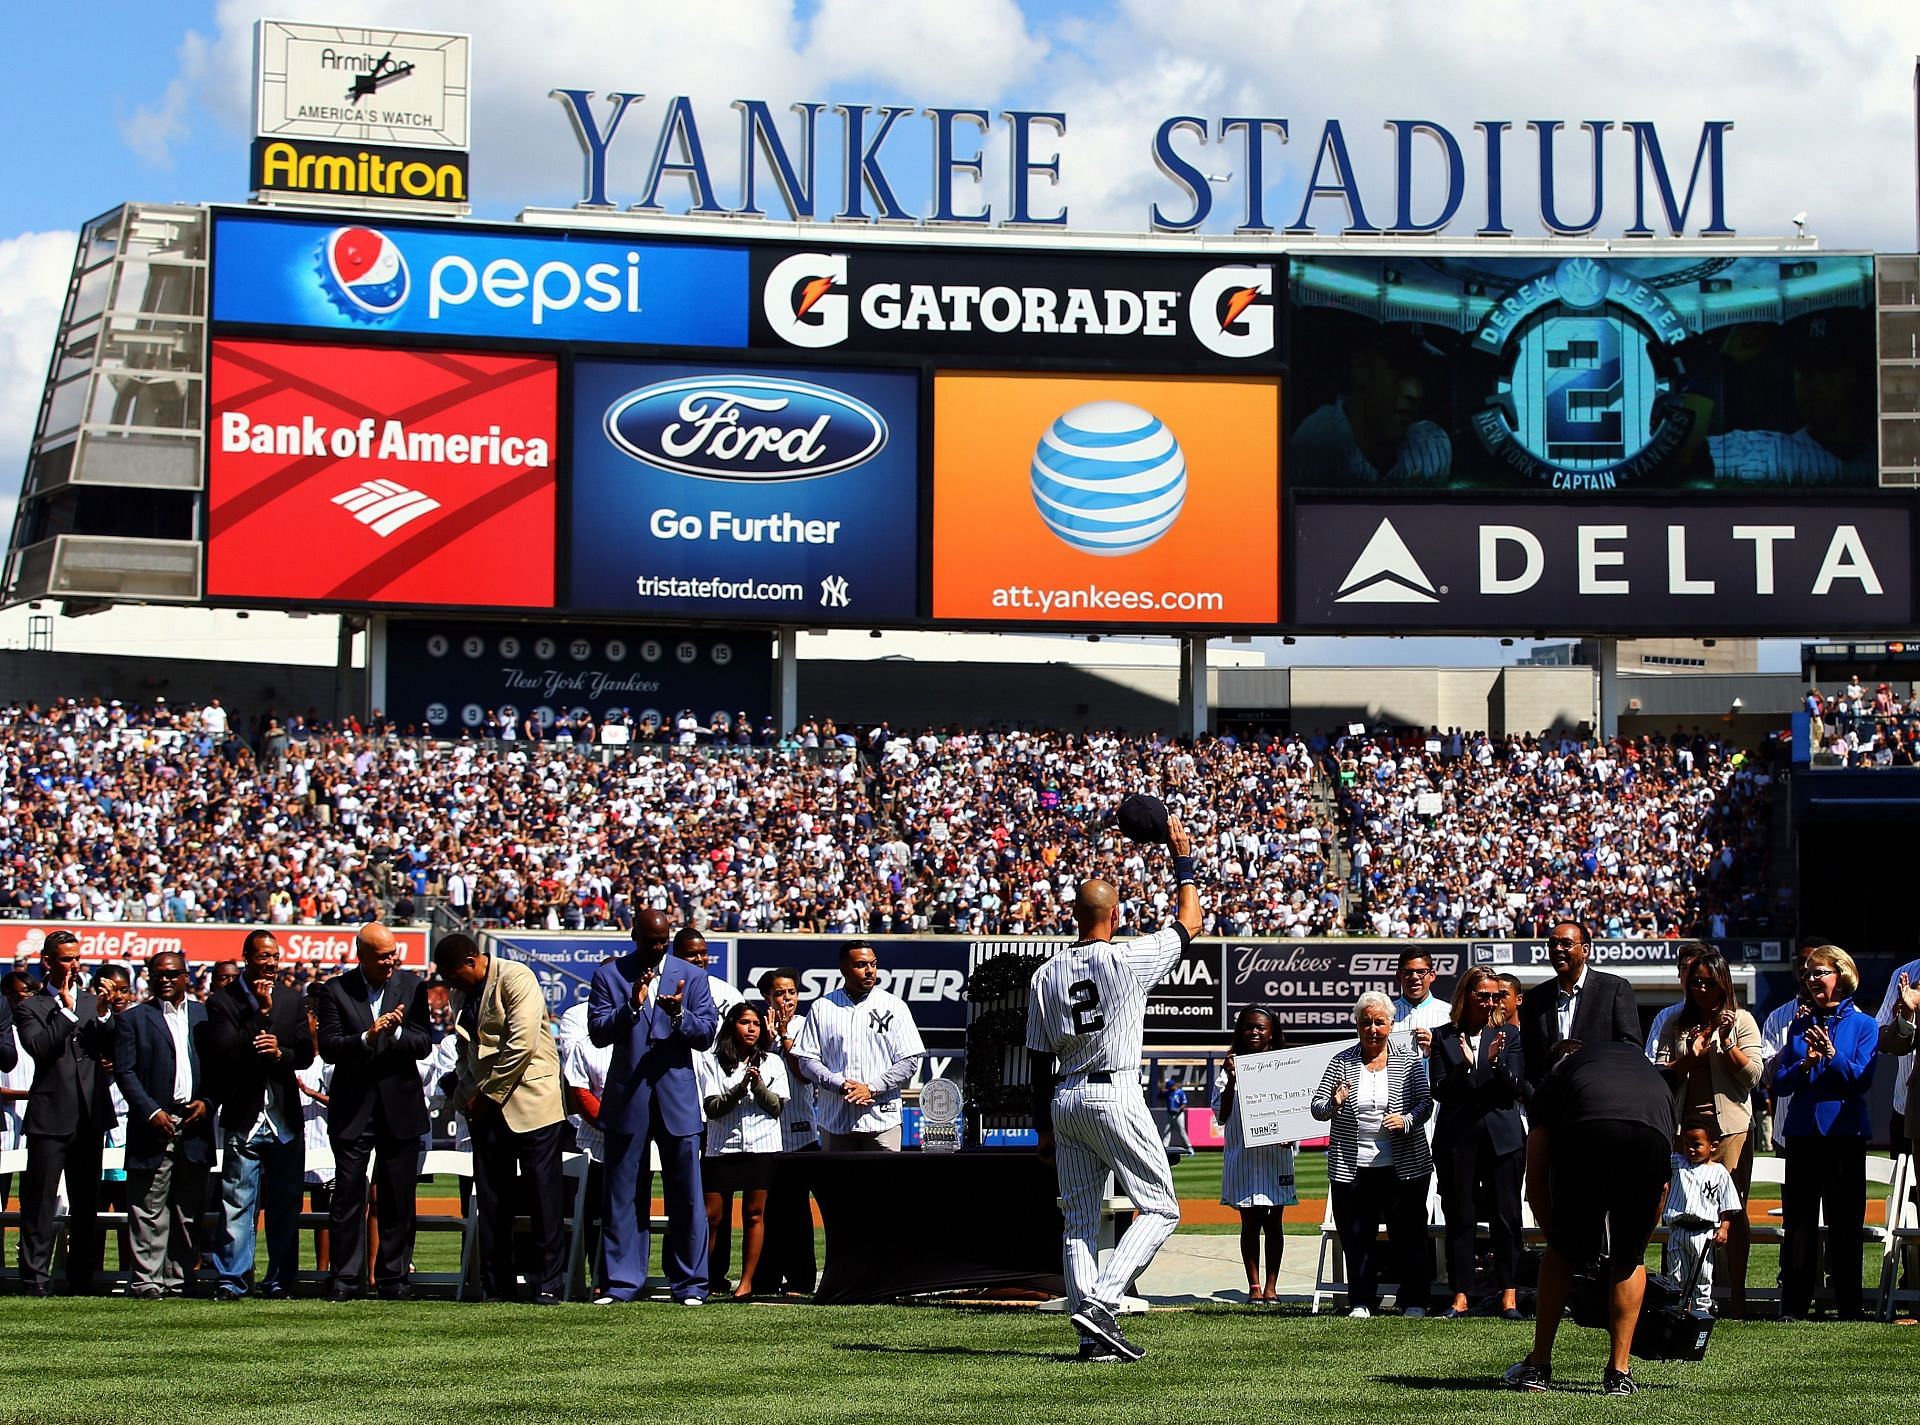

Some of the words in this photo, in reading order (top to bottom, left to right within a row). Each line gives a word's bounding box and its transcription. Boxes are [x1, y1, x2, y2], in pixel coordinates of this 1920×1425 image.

[299, 105, 378, 123] AMERICA'S
[383, 111, 433, 126] WATCH
[263, 142, 464, 200] Armitron
[549, 88, 1068, 226] YANKEE
[1151, 115, 1735, 236] STADIUM
[429, 251, 640, 325] pepsi
[763, 253, 850, 349] G
[860, 283, 1178, 337] GATORADE
[1480, 275, 1554, 345] DEREK
[1615, 278, 1687, 346] JETER
[1189, 264, 1275, 359] G
[1545, 317, 1624, 446] 2
[221, 411, 326, 458] Bank
[331, 417, 376, 459] of
[378, 420, 550, 469] America
[660, 390, 832, 463] Ford
[1552, 471, 1617, 490] CAPTAIN
[650, 509, 701, 541] Go
[709, 510, 841, 545] Further
[1479, 524, 1884, 595] DELTA
[637, 576, 804, 601] tristateford.com
[991, 584, 1224, 614] att.yankees.com
[433, 639, 441, 652] 4
[469, 640, 478, 653] 3
[505, 640, 514, 653] 5
[541, 642, 549, 655] 7
[501, 668, 541, 689] New
[543, 670, 588, 699] York
[588, 671, 660, 700] Yankees
[429, 707, 444, 720] 32
[468, 708, 477, 721] 9
[73, 929, 120, 956] tate
[1234, 946, 1332, 985] Yankees
[1068, 979, 1106, 1035] 2
[1269, 1092, 1283, 1101] The
[1283, 1090, 1300, 1099] Turn
[1301, 1088, 1306, 1096] 2
[1250, 1126, 1269, 1135] TURN
[1270, 1121, 1279, 1132] 2
